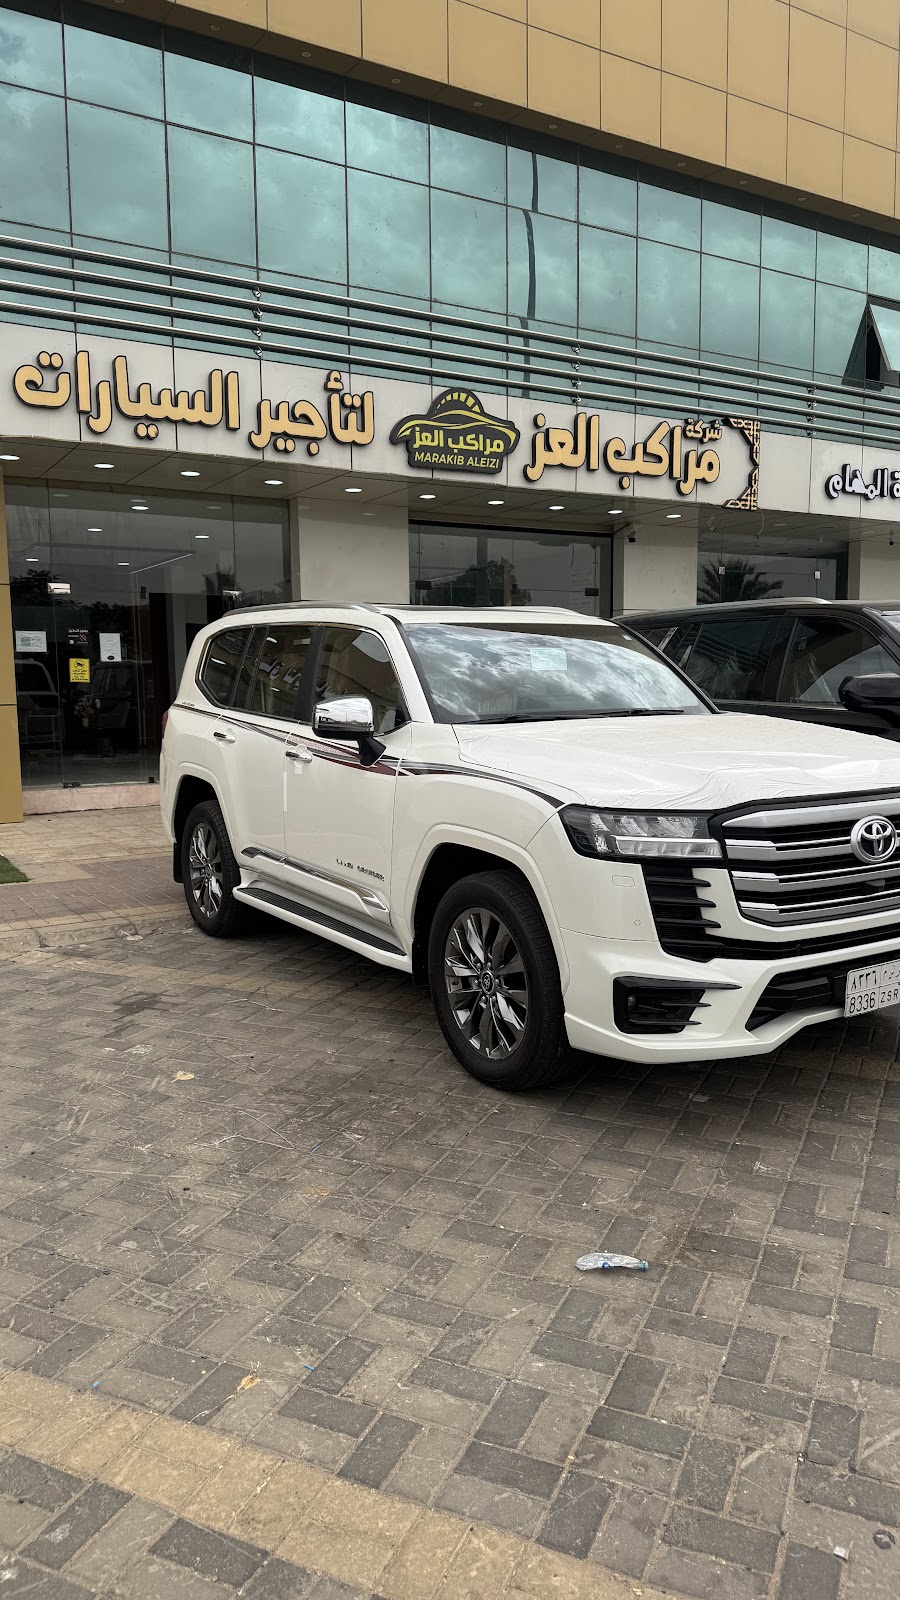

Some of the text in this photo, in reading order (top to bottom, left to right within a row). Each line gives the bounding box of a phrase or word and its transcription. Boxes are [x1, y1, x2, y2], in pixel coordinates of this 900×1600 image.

[13, 350, 375, 456] لتأجير السيارات
[413, 426, 505, 455] مراكب العز
[684, 417, 723, 443] شركة
[414, 451, 500, 469] MARAKIB ALEIZI
[523, 412, 721, 496] مراكب العز
[849, 991, 876, 1013] 8336
